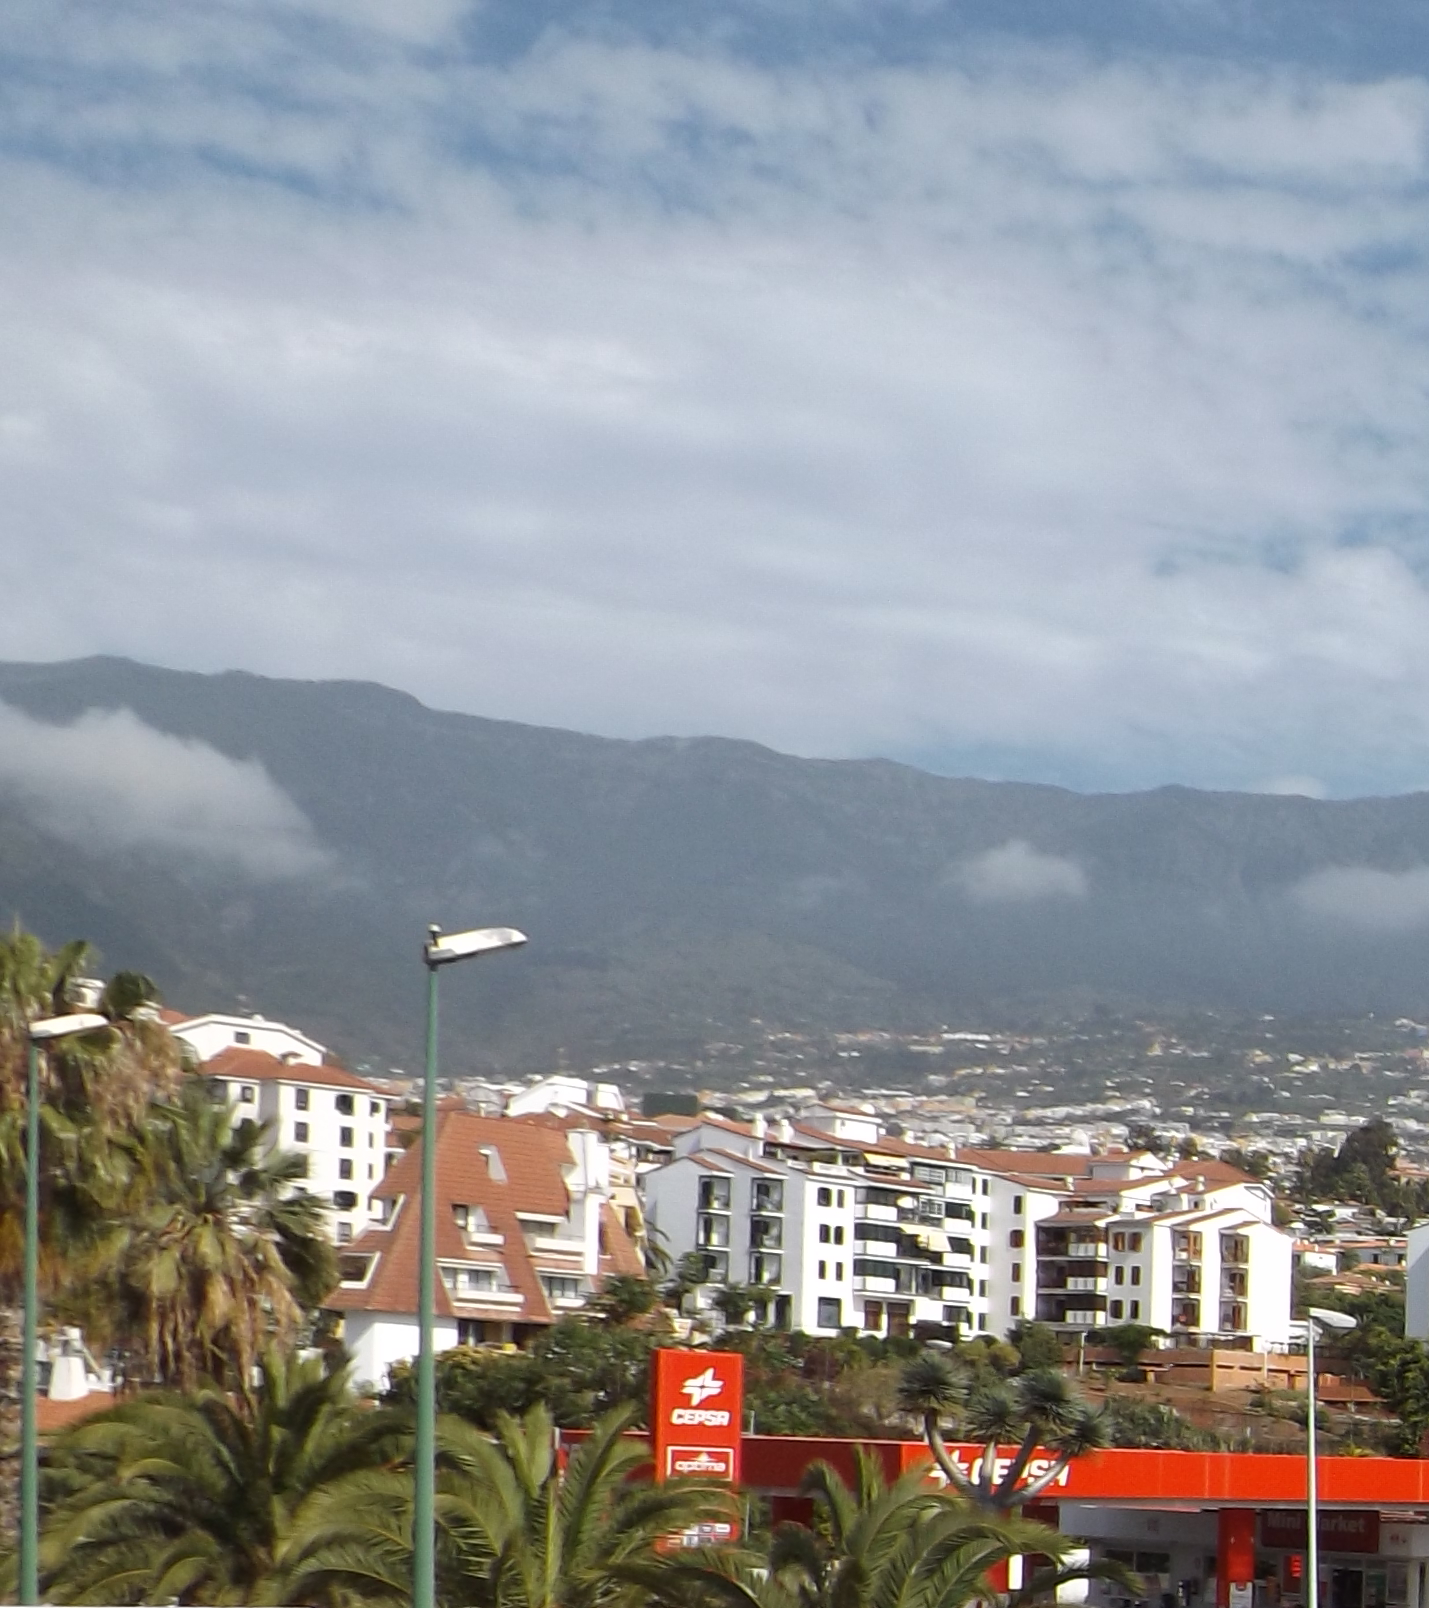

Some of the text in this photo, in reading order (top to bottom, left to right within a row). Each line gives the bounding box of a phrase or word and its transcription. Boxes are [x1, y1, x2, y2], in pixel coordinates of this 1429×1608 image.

[670, 1409, 730, 1426] CEPSA
[970, 1458, 1071, 1487] CESA
[1267, 1513, 1365, 1533] Mini arket
